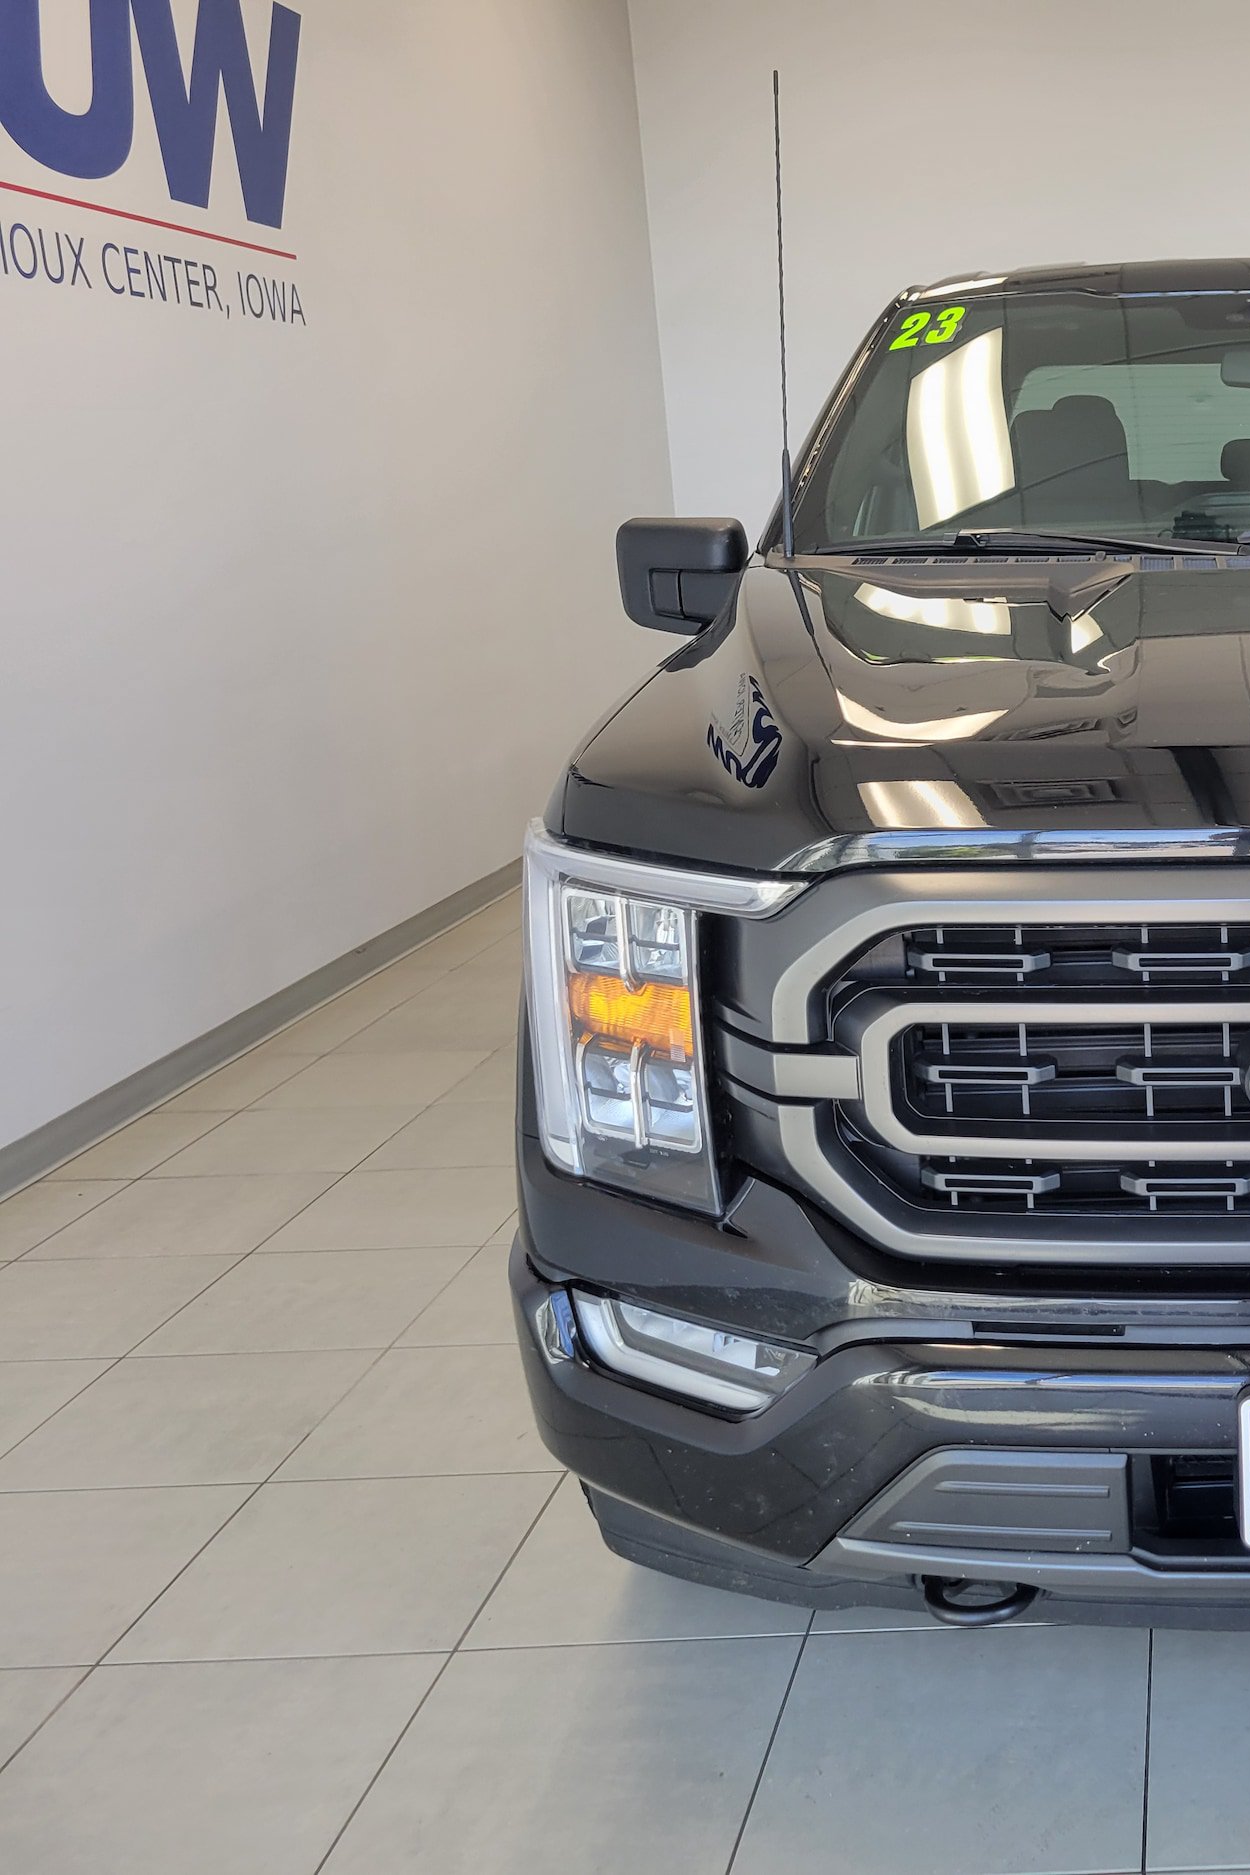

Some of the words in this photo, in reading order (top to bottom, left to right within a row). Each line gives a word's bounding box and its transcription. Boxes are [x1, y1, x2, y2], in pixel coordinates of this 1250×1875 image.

[101, 242, 230, 320] CENTER,
[236, 271, 307, 326] IOWA
[888, 306, 966, 351] 23
